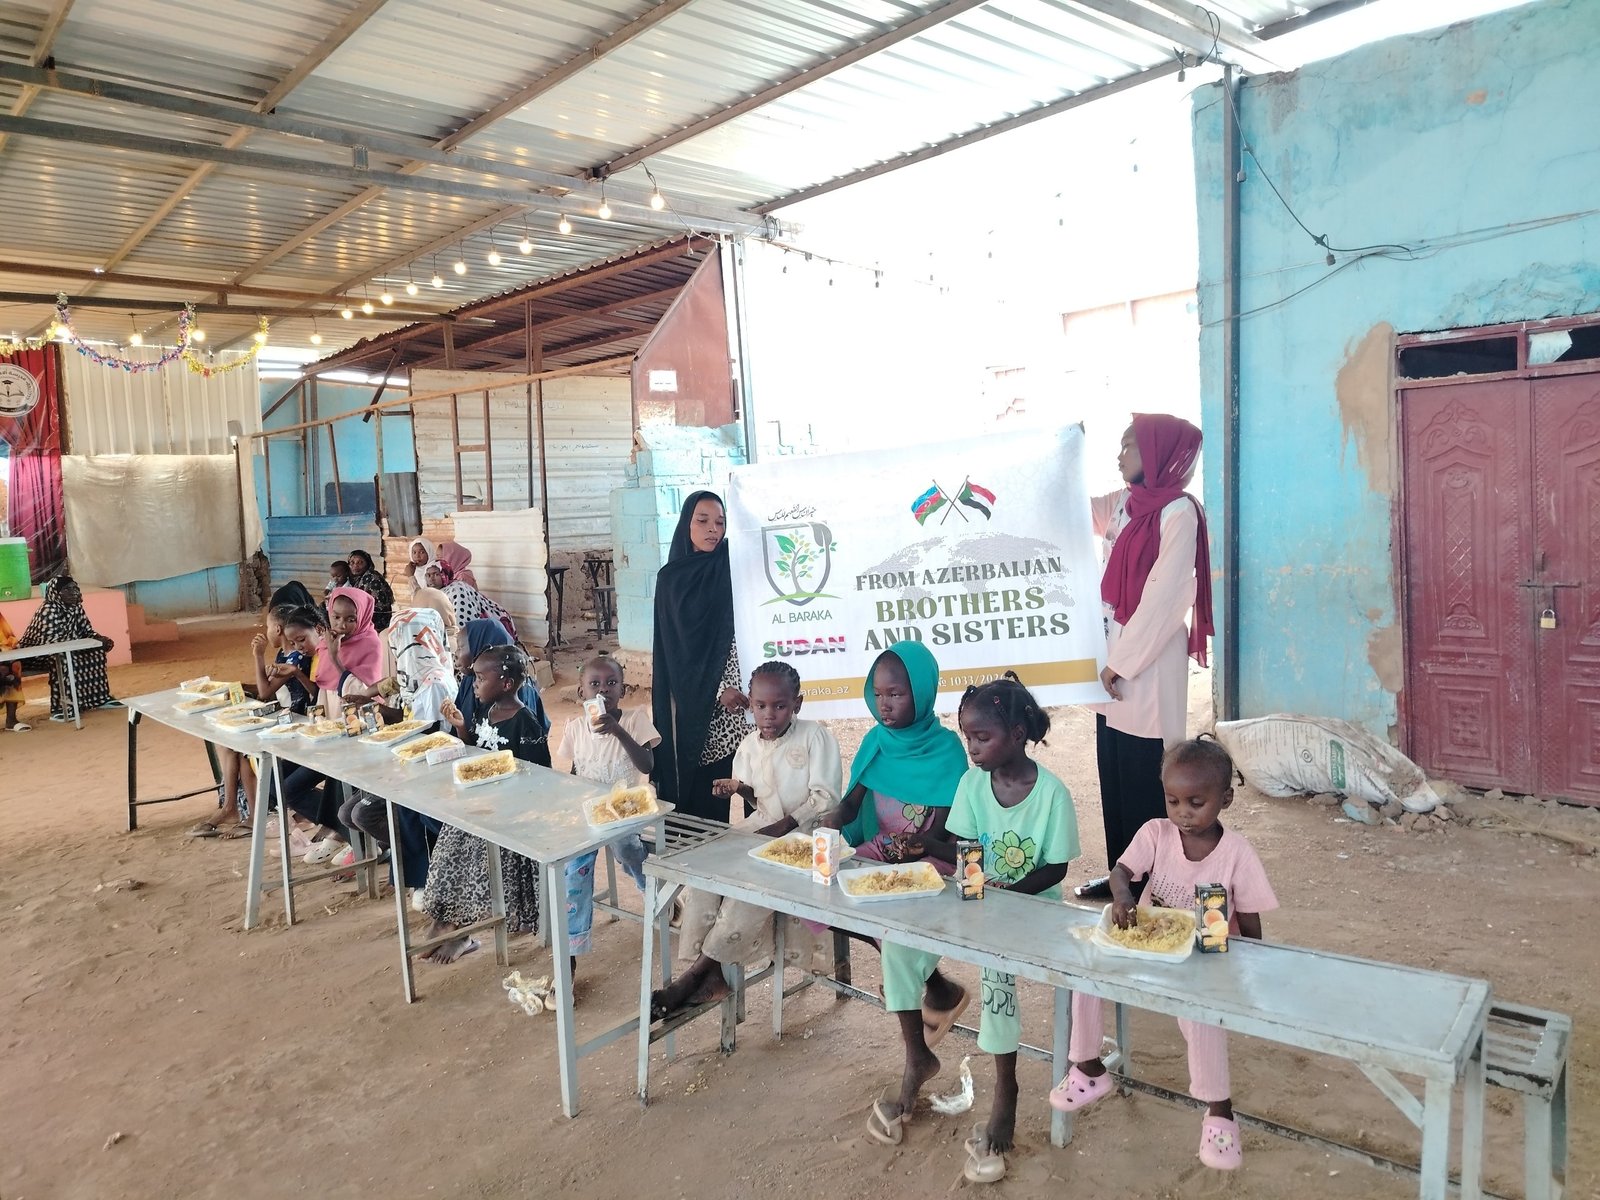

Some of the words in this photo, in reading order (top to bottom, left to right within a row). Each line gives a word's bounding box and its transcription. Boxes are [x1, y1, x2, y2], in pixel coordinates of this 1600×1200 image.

[855, 570, 916, 591] FROM
[921, 556, 1062, 586] AZERBAIJAN
[771, 613, 786, 624] AL
[788, 609, 833, 623] BARAKA
[875, 586, 1046, 623] BROTHERS
[864, 625, 923, 651] AND
[931, 612, 1070, 646] SISTERS
[762, 635, 846, 659] SUDAN
[798, 685, 850, 698] araka_az
